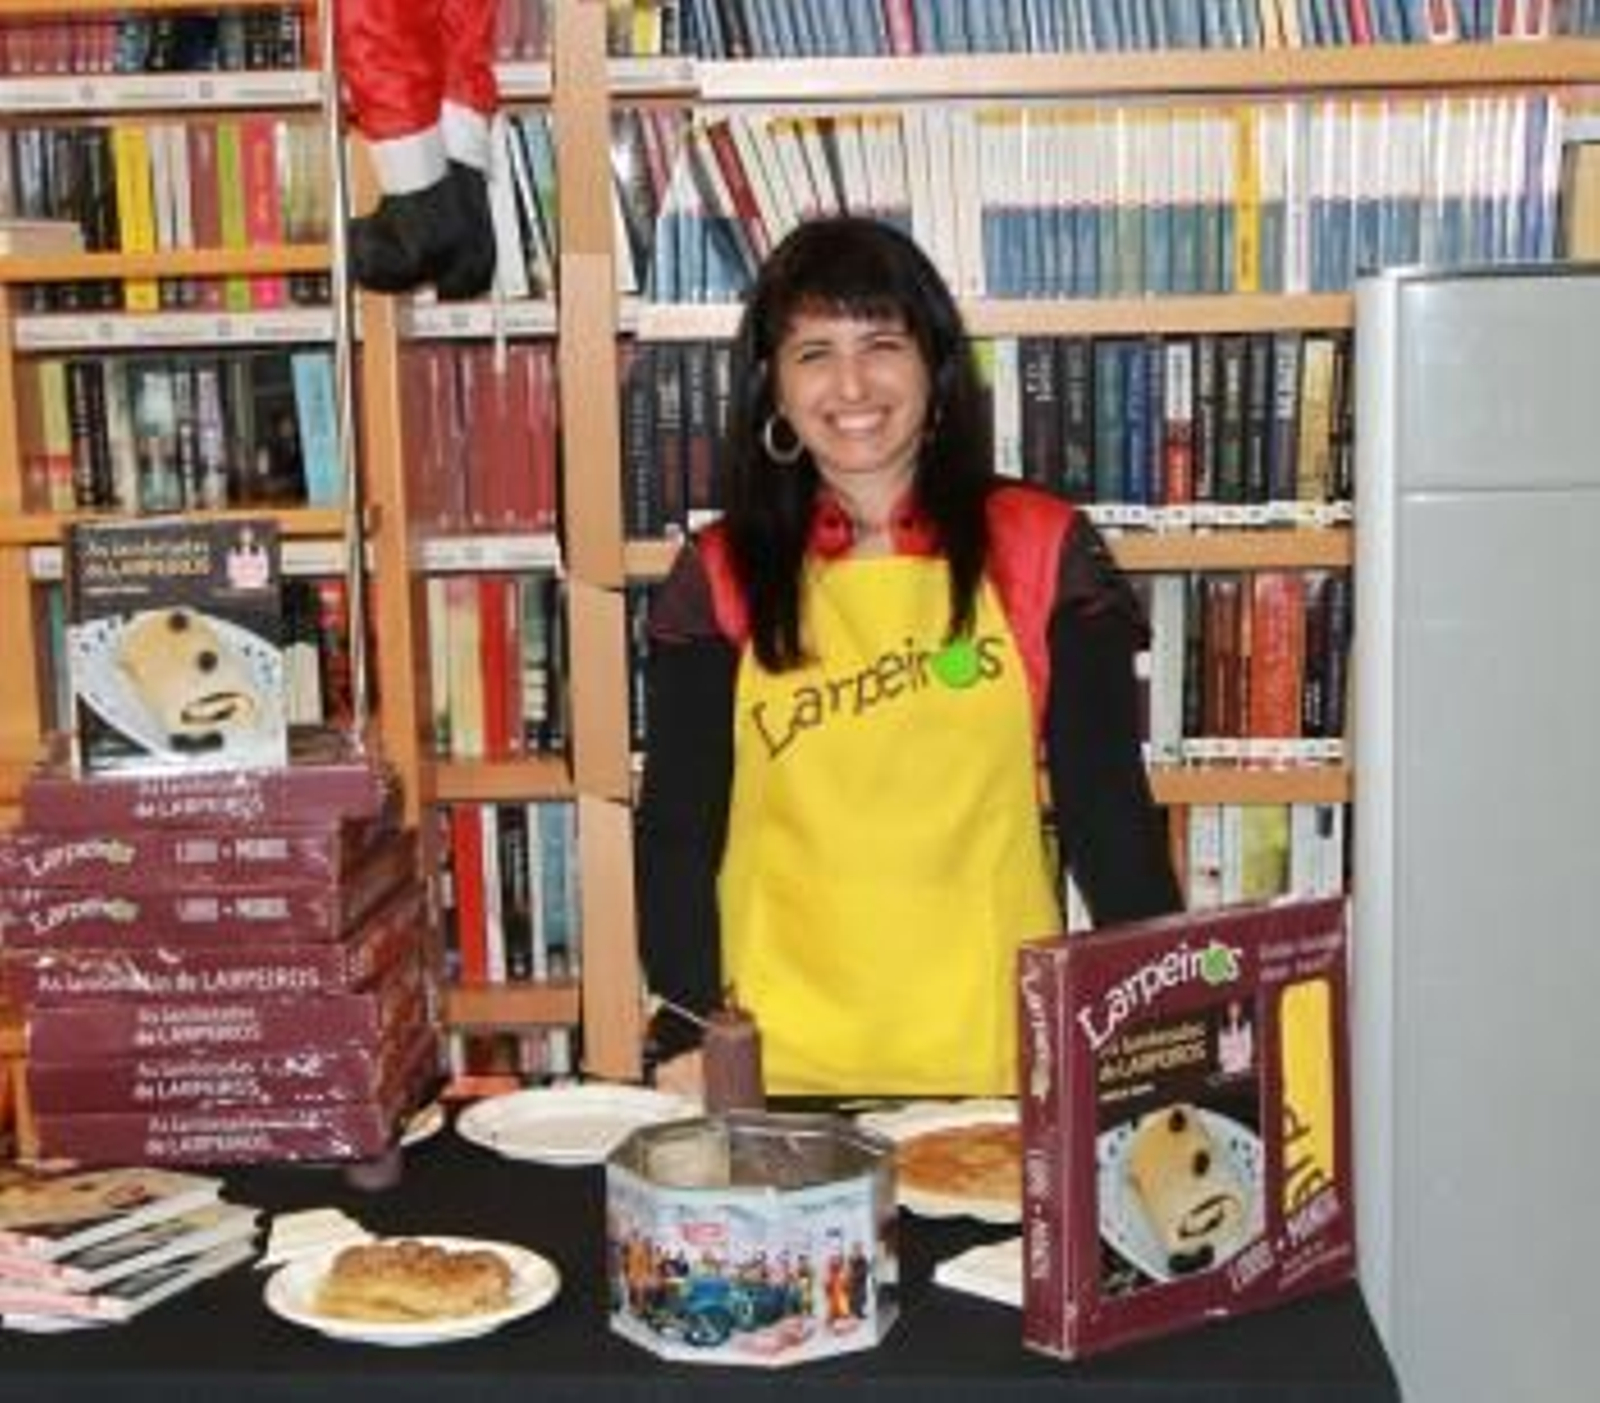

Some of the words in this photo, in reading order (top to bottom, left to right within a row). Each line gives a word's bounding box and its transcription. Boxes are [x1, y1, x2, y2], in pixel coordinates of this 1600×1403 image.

[752, 636, 1004, 759] Larpeiros
[203, 967, 321, 991] LARPEIROS
[1075, 938, 1244, 1050] Larpeiros
